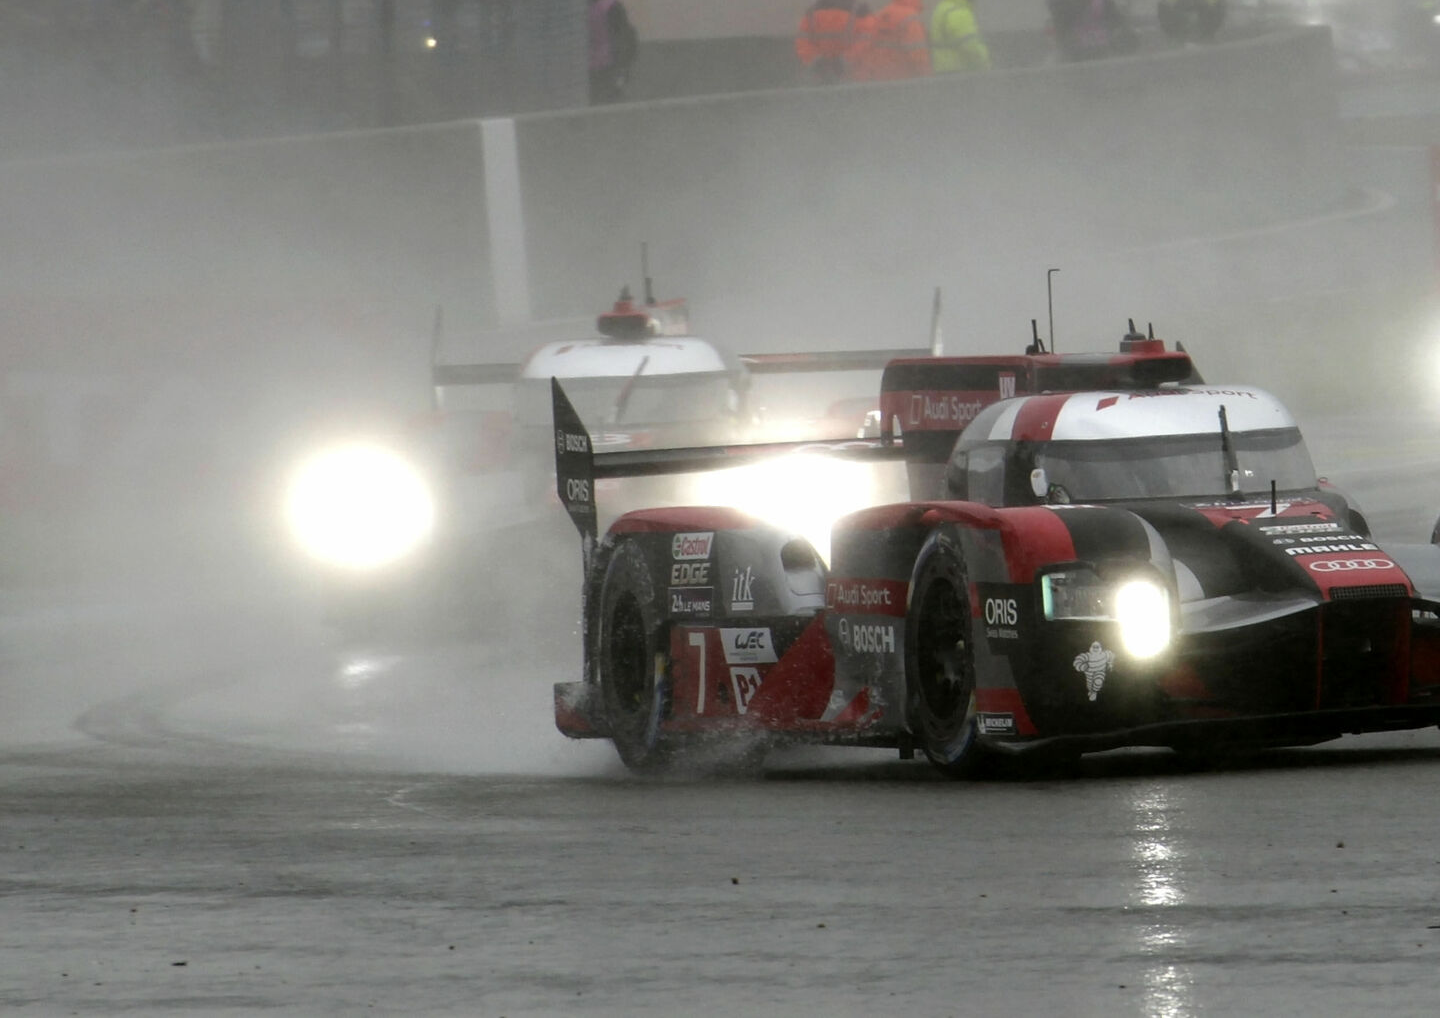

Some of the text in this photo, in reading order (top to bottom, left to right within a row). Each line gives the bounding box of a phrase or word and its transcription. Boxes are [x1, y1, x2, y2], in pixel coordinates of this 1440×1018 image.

[565, 433, 588, 453] BOSCH
[566, 478, 589, 502] ORIS
[1284, 543, 1378, 556] MAHLE
[1299, 535, 1364, 543] BOSCH
[670, 562, 711, 586] EDGE
[731, 565, 756, 601] itk
[838, 584, 892, 609] Audi Sport
[985, 598, 1017, 625] ORIS
[735, 631, 765, 649] WEC
[853, 625, 895, 653] BOSCH
